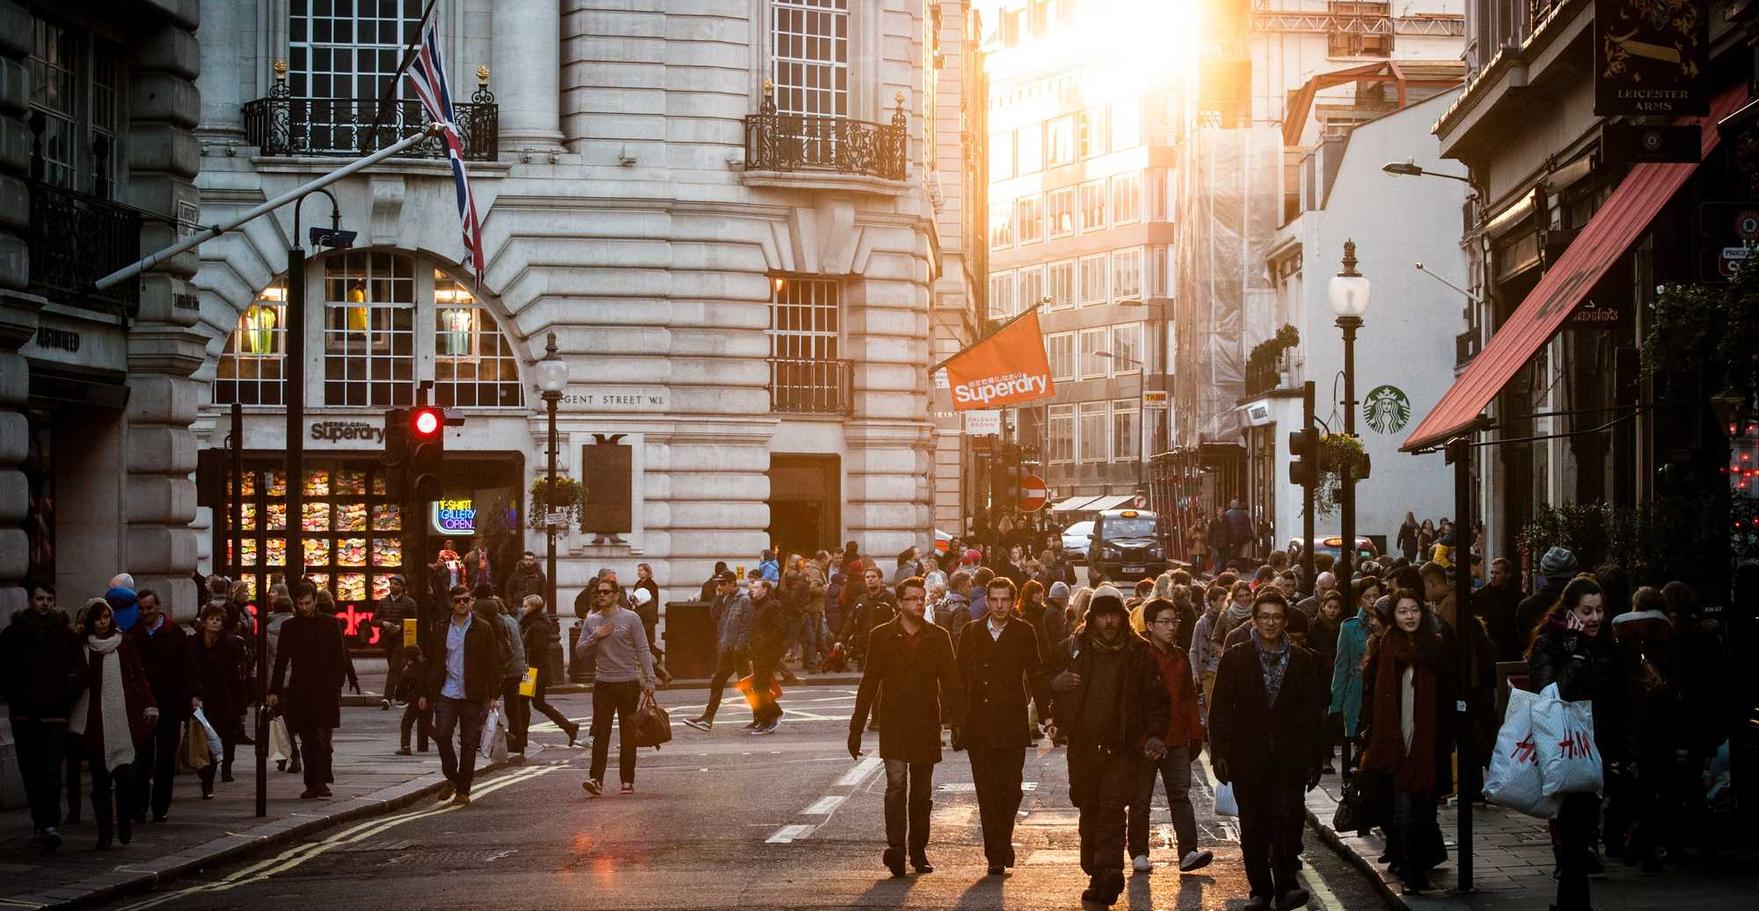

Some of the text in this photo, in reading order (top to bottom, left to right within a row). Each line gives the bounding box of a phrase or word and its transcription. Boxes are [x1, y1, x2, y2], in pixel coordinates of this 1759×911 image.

[1617, 89, 1689, 100] LEICESTER
[1635, 101, 1673, 111] ARMS
[954, 374, 1047, 404] Superdry
[559, 395, 594, 404] GENT
[602, 395, 641, 405] STREET
[311, 423, 386, 444] Superdry
[439, 499, 472, 511] T-SHIRT
[1557, 729, 1594, 762] H&M
